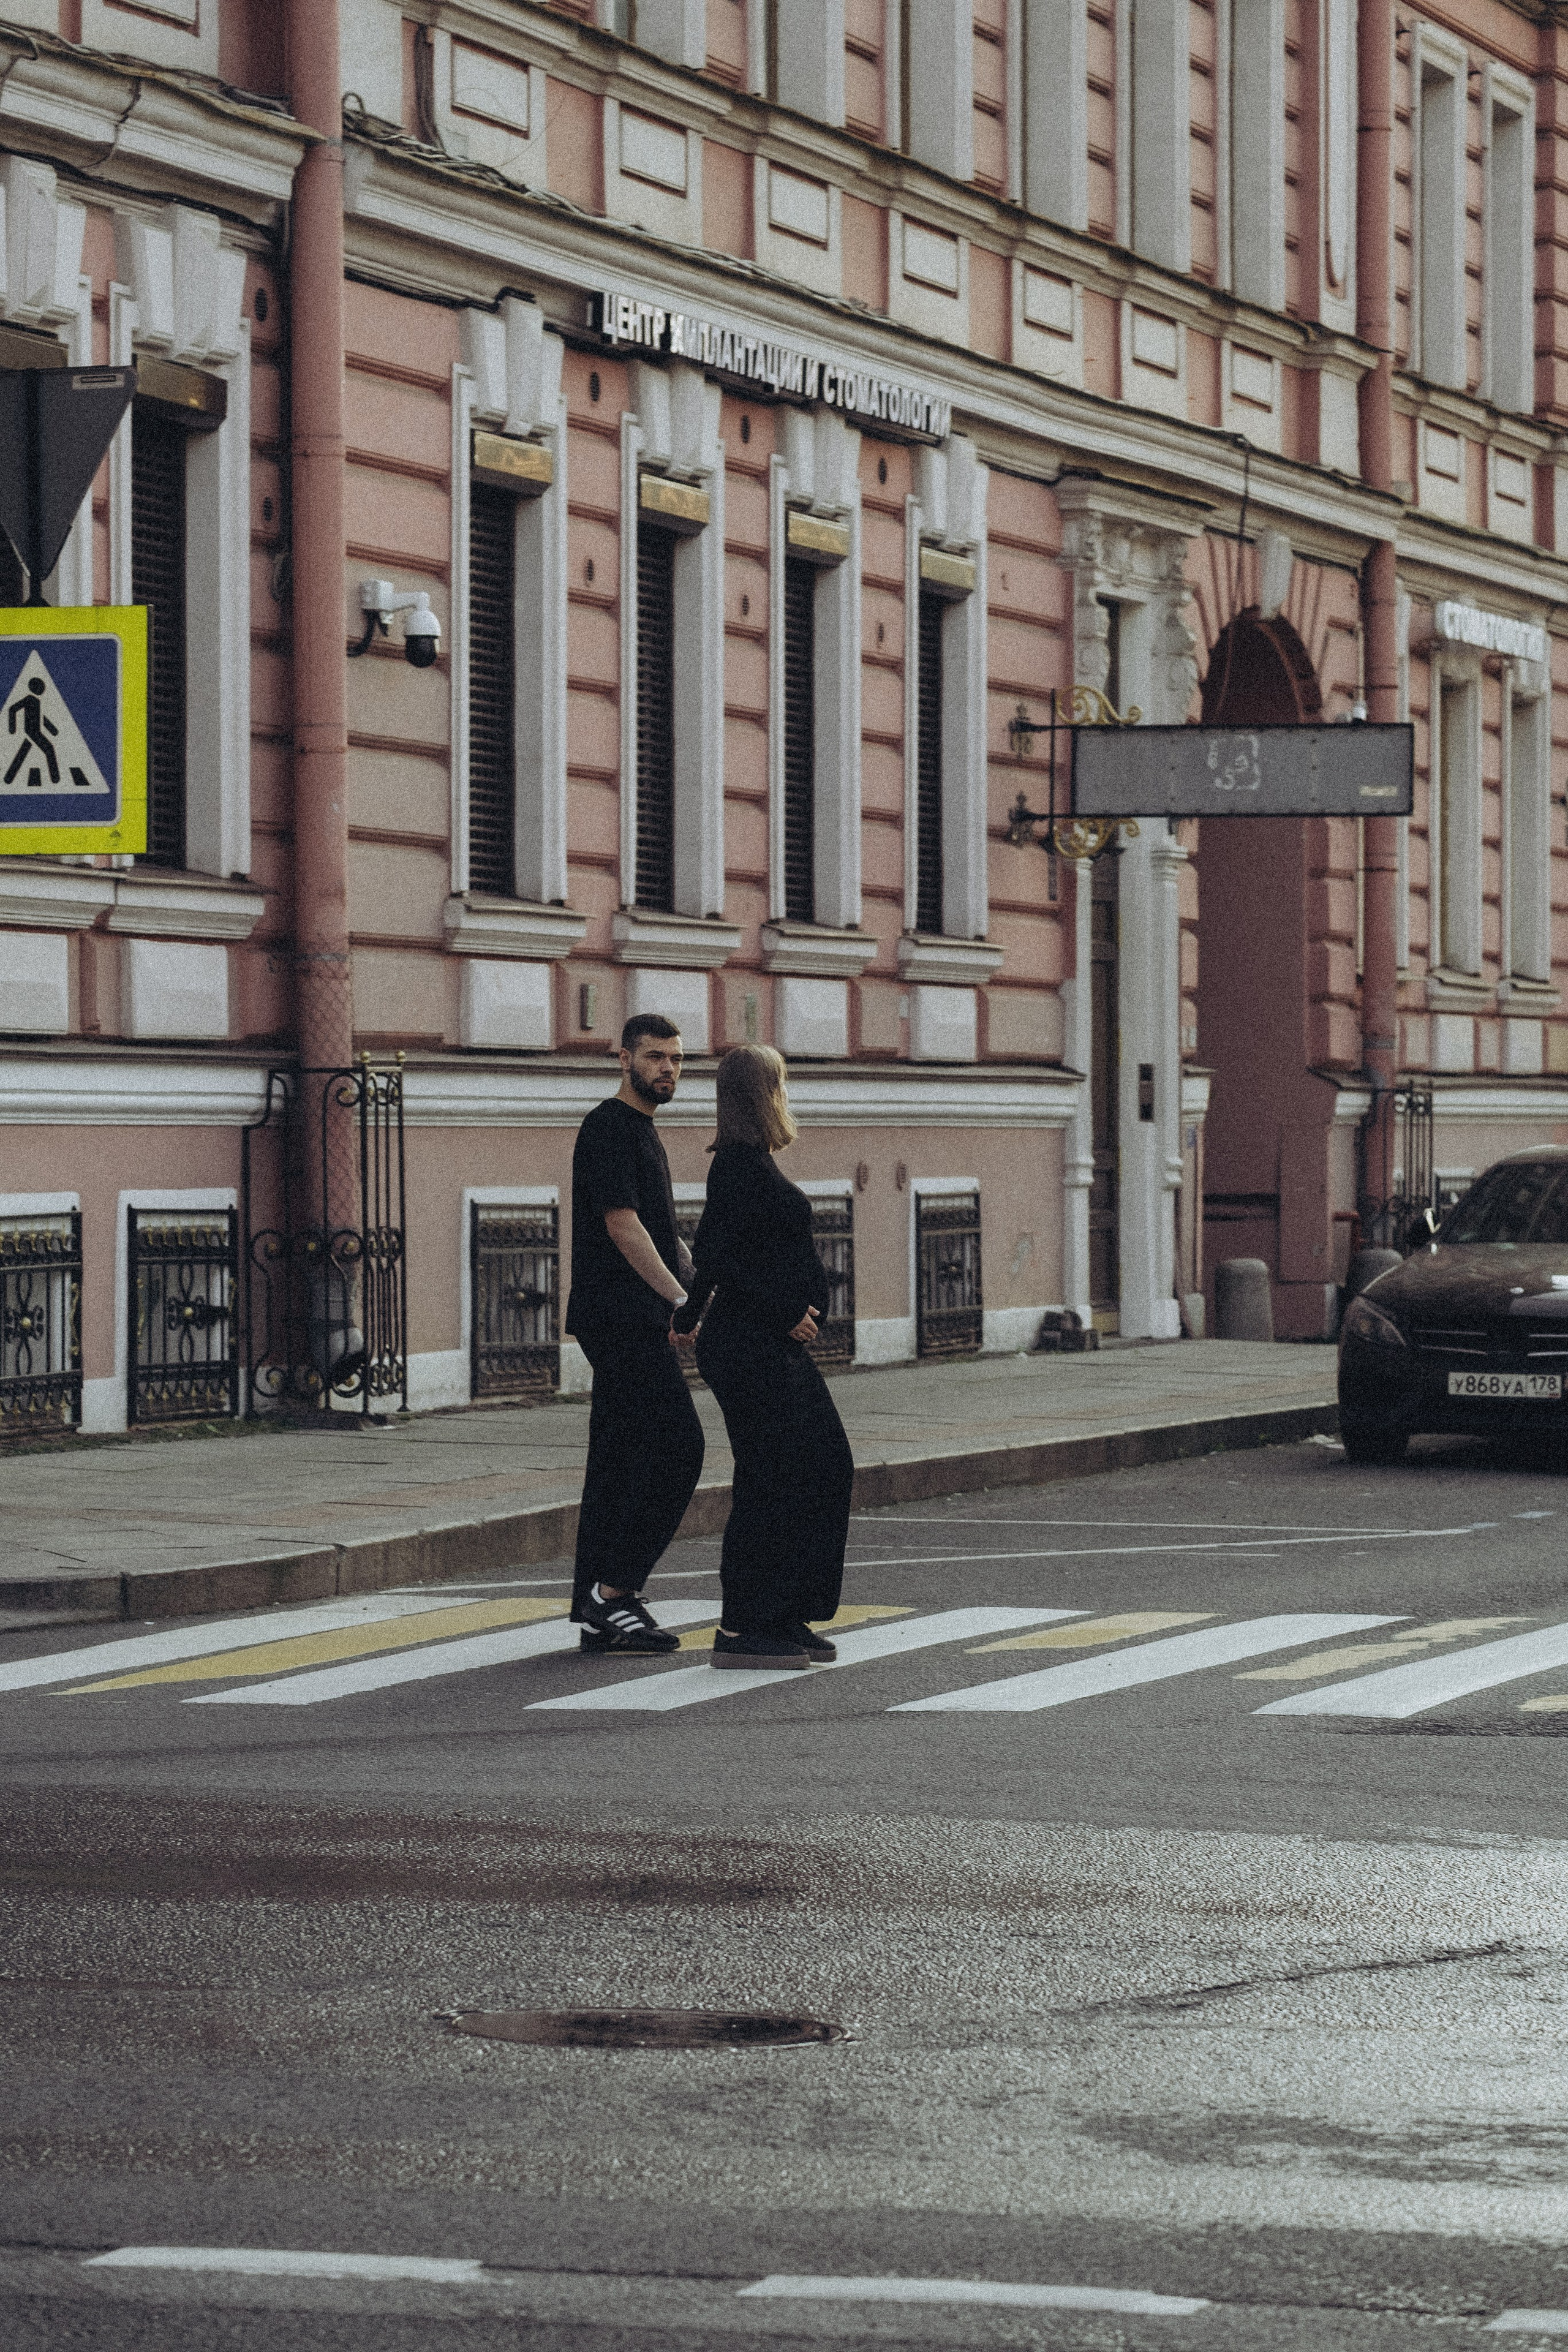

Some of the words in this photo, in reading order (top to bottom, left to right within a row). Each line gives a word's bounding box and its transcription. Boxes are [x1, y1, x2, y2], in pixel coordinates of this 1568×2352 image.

[603, 293, 666, 350] ЦЕНТР
[805, 357, 819, 399] И
[823, 363, 951, 439] СТОМАТОЛОГИИ
[1529, 1376, 1557, 1391] 178
